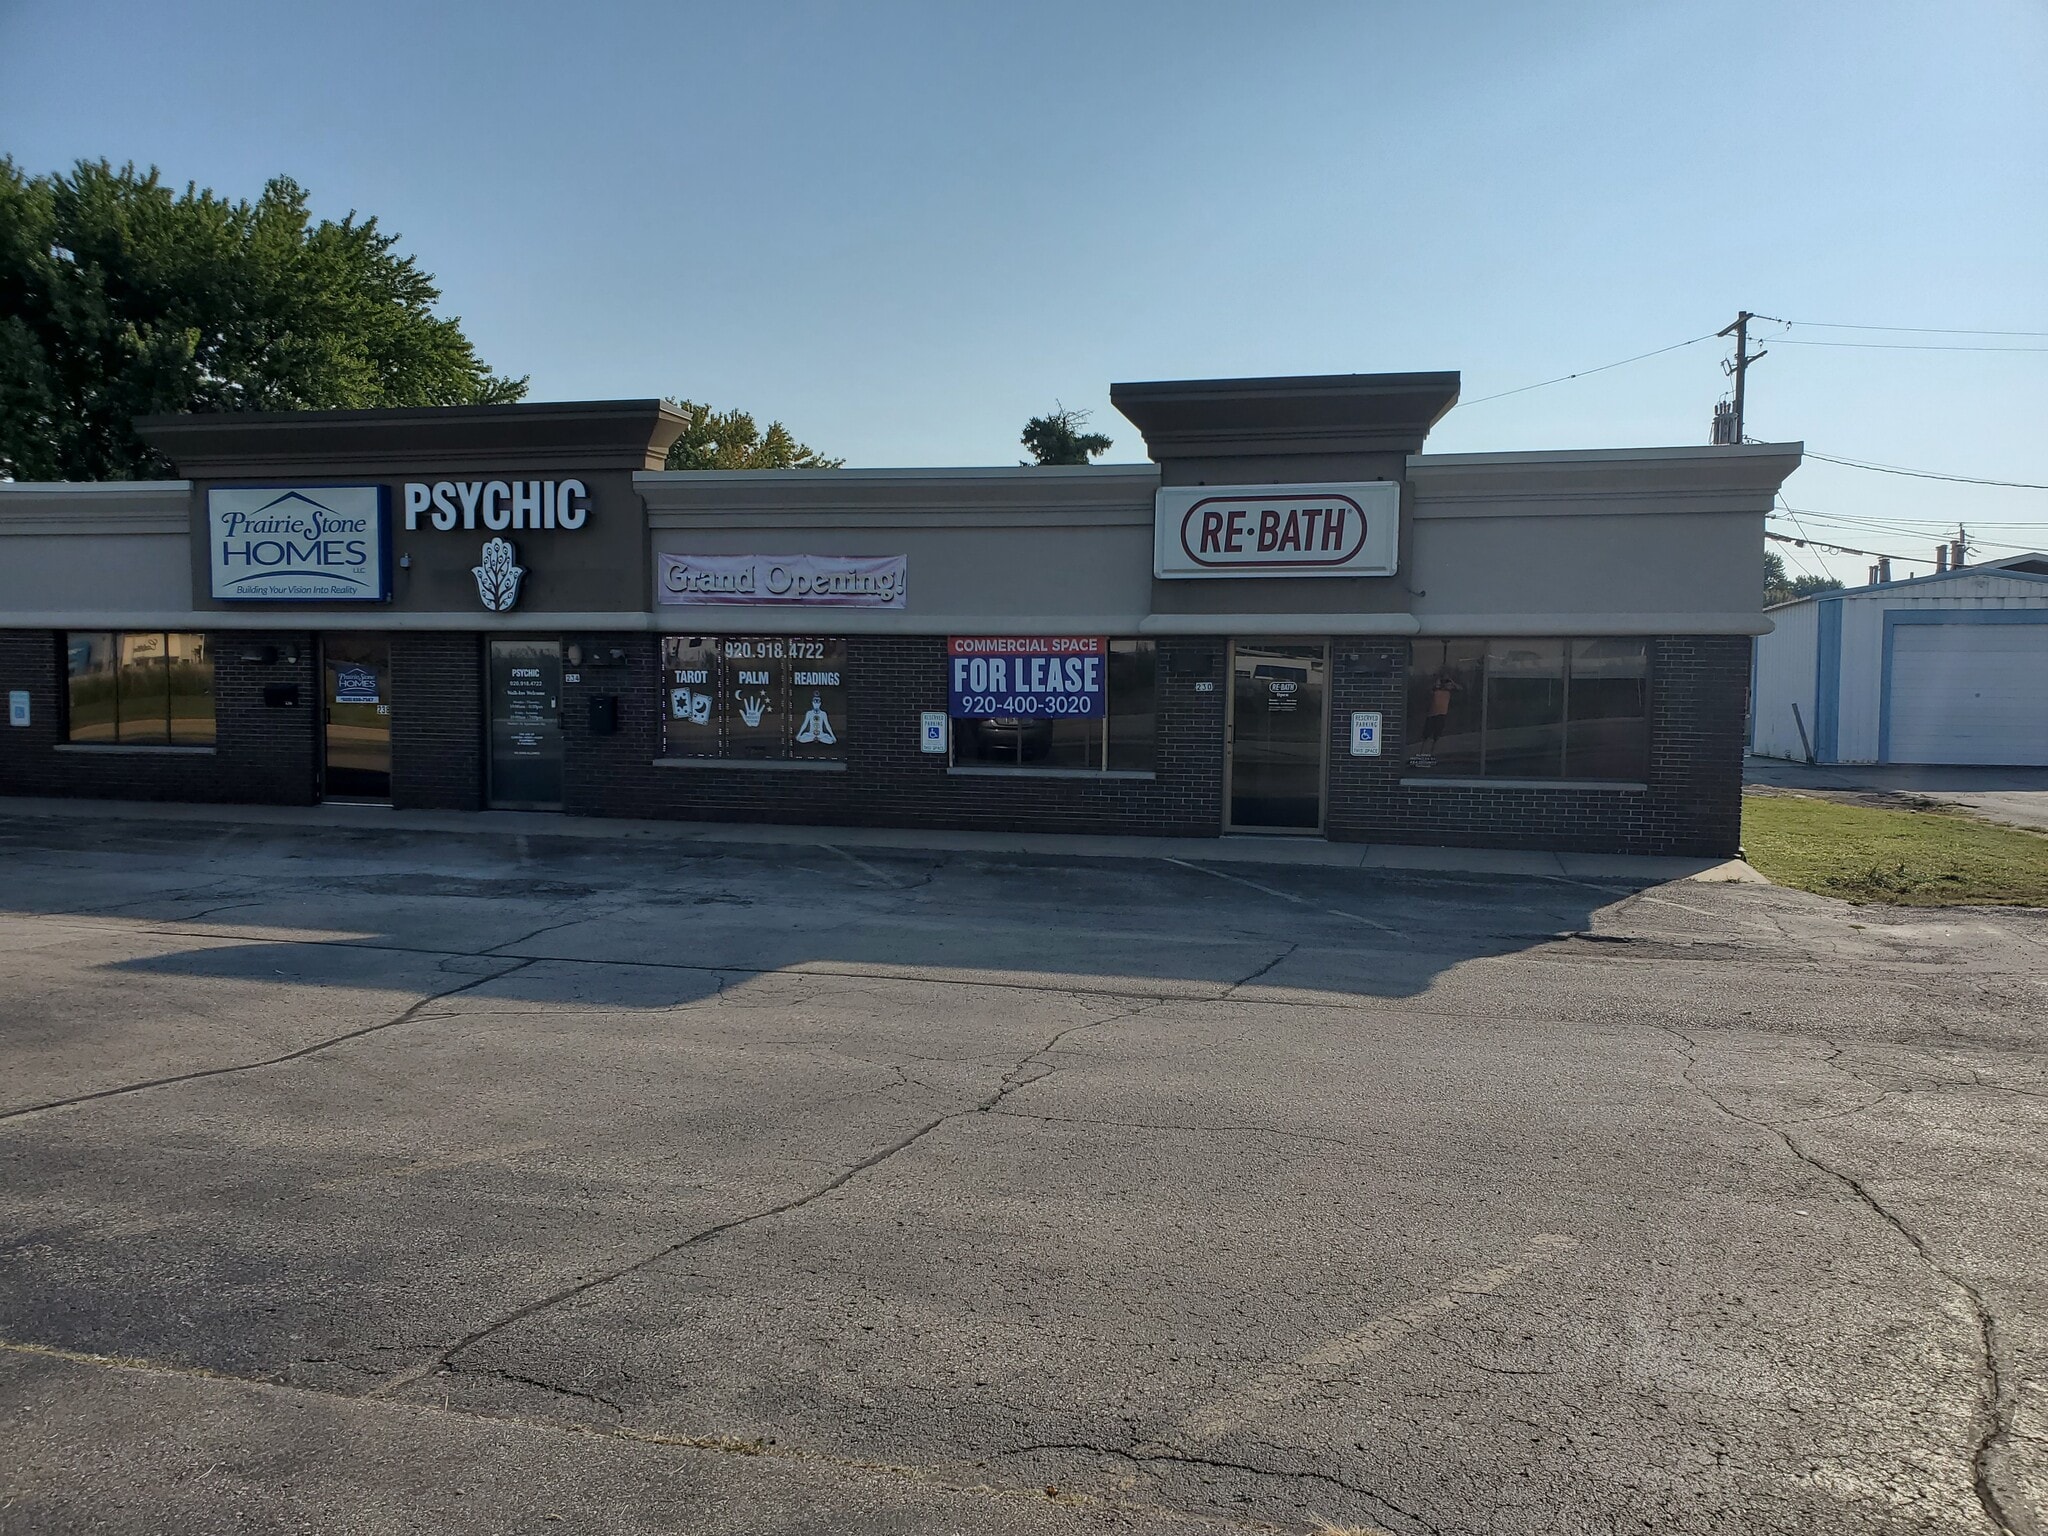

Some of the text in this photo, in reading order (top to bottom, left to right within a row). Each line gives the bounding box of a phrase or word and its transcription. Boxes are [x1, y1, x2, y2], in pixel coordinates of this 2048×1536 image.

[404, 479, 587, 531] PSYCHIC
[221, 511, 366, 541] Prairie Stone
[223, 541, 367, 565] HOMES
[236, 585, 357, 595] Building Your Vision Into Reality
[665, 563, 905, 601] Grand Opening!
[725, 642, 824, 659] 920.918.4722
[954, 639, 1098, 652] COMMERCIAL SPACE
[512, 668, 540, 677] PSYCHIC
[566, 674, 580, 682] 234
[674, 670, 840, 686] TAROT PALM READINGS
[954, 657, 1099, 692] FOR LEASE
[1196, 683, 1212, 691] 230
[962, 696, 1092, 713] 920-400-3020
